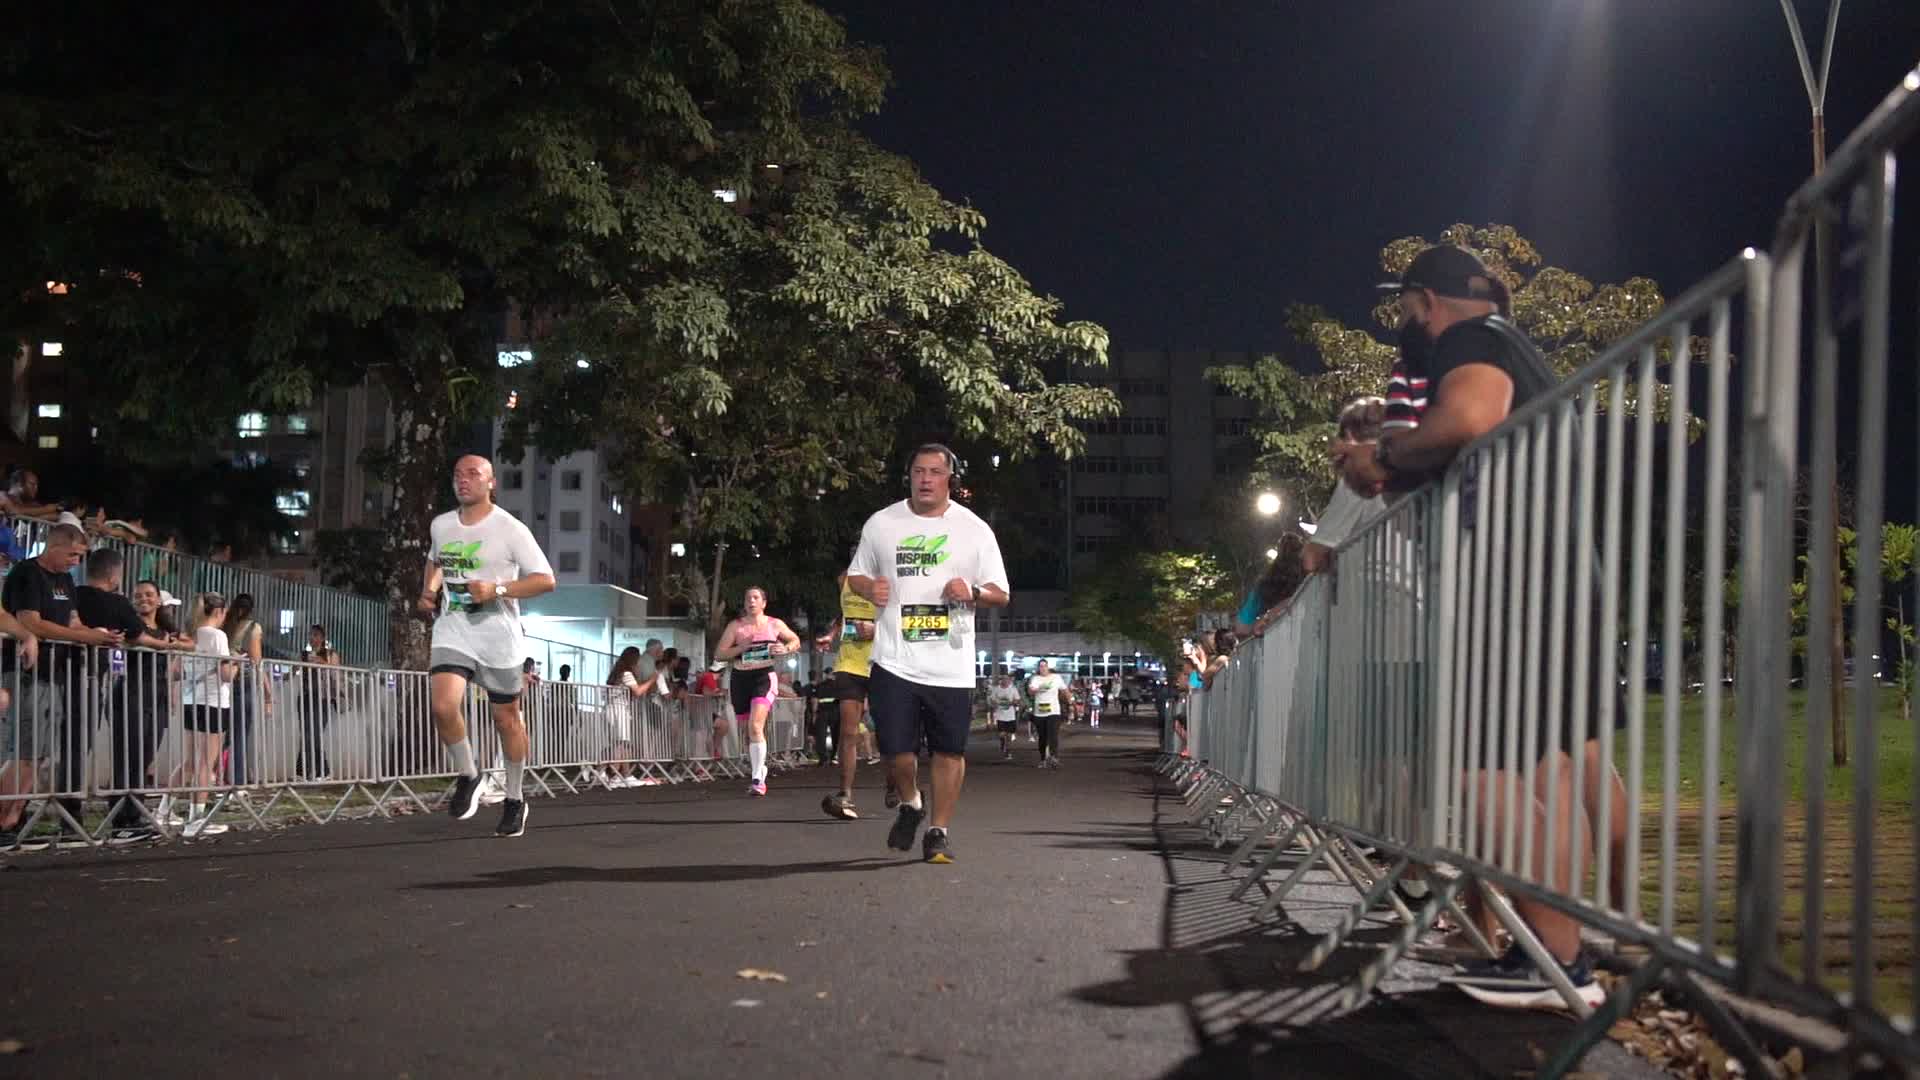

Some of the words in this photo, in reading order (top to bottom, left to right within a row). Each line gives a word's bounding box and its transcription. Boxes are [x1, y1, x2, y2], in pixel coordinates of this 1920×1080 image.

[896, 552, 938, 566] INSPIRA
[896, 566, 920, 577] NIGHT
[909, 617, 942, 629] 2265
